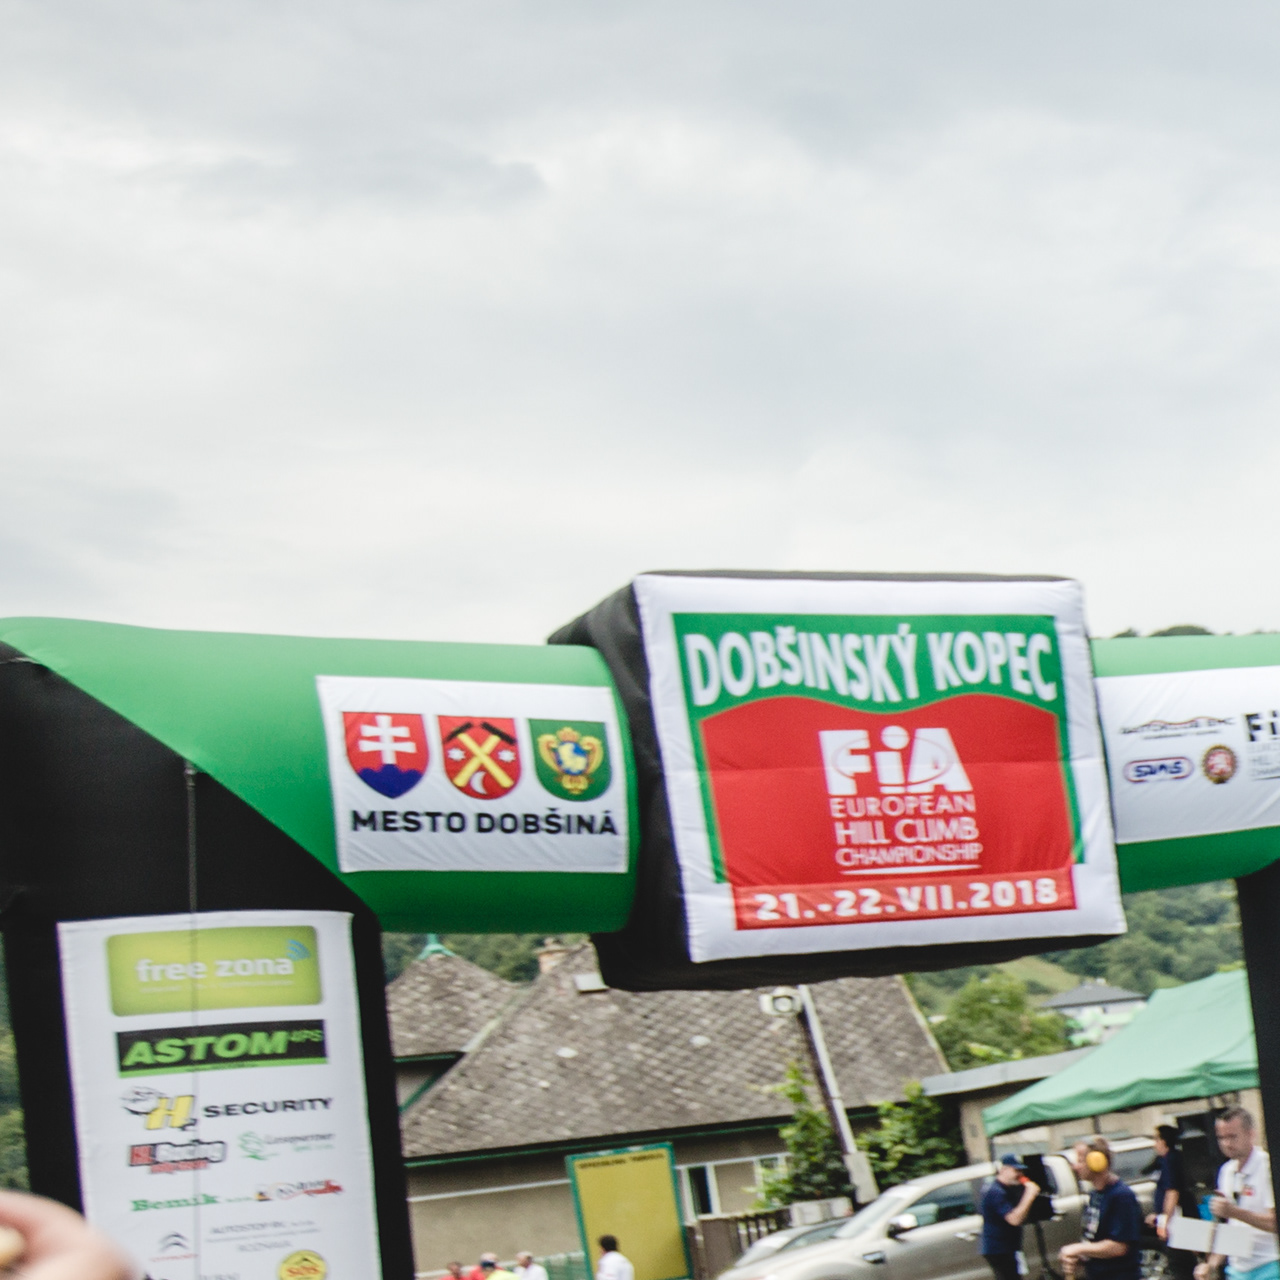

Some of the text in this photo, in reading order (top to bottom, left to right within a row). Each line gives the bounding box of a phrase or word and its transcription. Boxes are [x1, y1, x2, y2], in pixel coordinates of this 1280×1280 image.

[683, 623, 1058, 706] DOBŠINSKÝ KOPEC
[829, 793, 976, 819] EUROPEAN
[351, 806, 618, 836] MESTO DOBŠINÁ
[834, 816, 979, 845] HILL CLIMB
[835, 841, 984, 868] CHAMPIONSHIP
[136, 957, 295, 983] free zona
[121, 1030, 290, 1066] ASTOM
[204, 1098, 332, 1118] SECURITY
